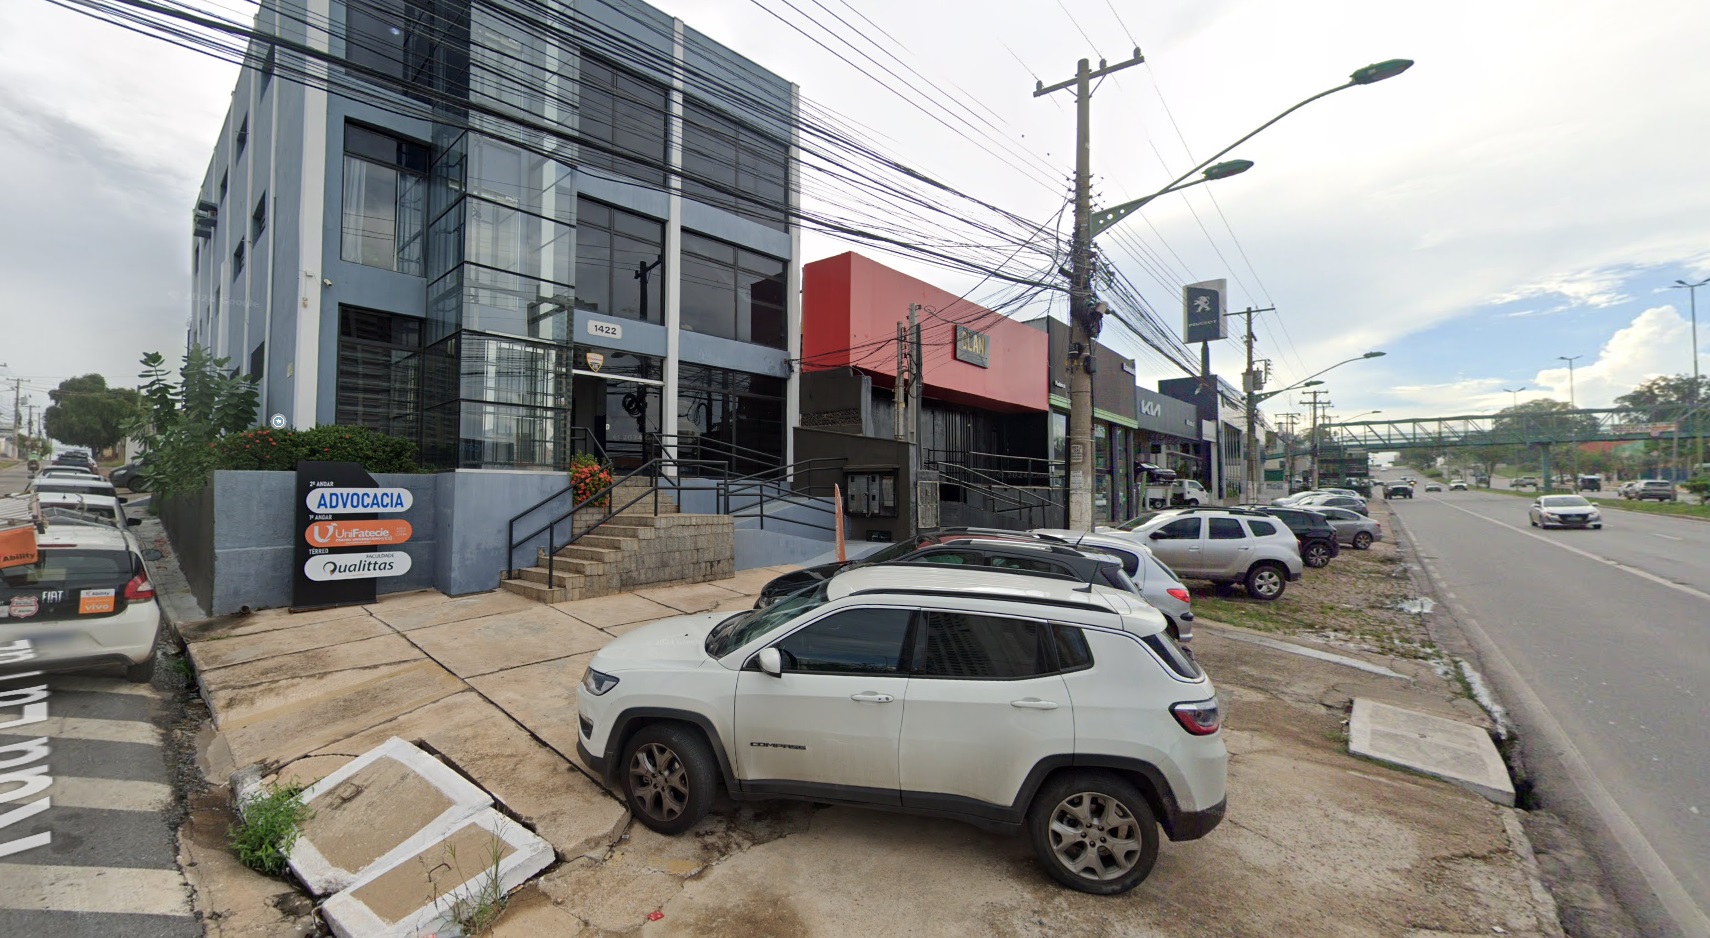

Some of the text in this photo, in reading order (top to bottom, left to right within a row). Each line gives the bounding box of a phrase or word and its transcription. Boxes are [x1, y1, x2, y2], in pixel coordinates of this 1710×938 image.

[594, 324, 617, 336] 1422
[317, 492, 404, 509] ADVOCACIA
[335, 527, 390, 539] UniFatecie
[2, 552, 36, 563] Ability
[322, 559, 394, 576] Qualittas
[42, 590, 64, 603] FIAT
[85, 603, 110, 611] vivo
[750, 741, 807, 750] COMPASS
